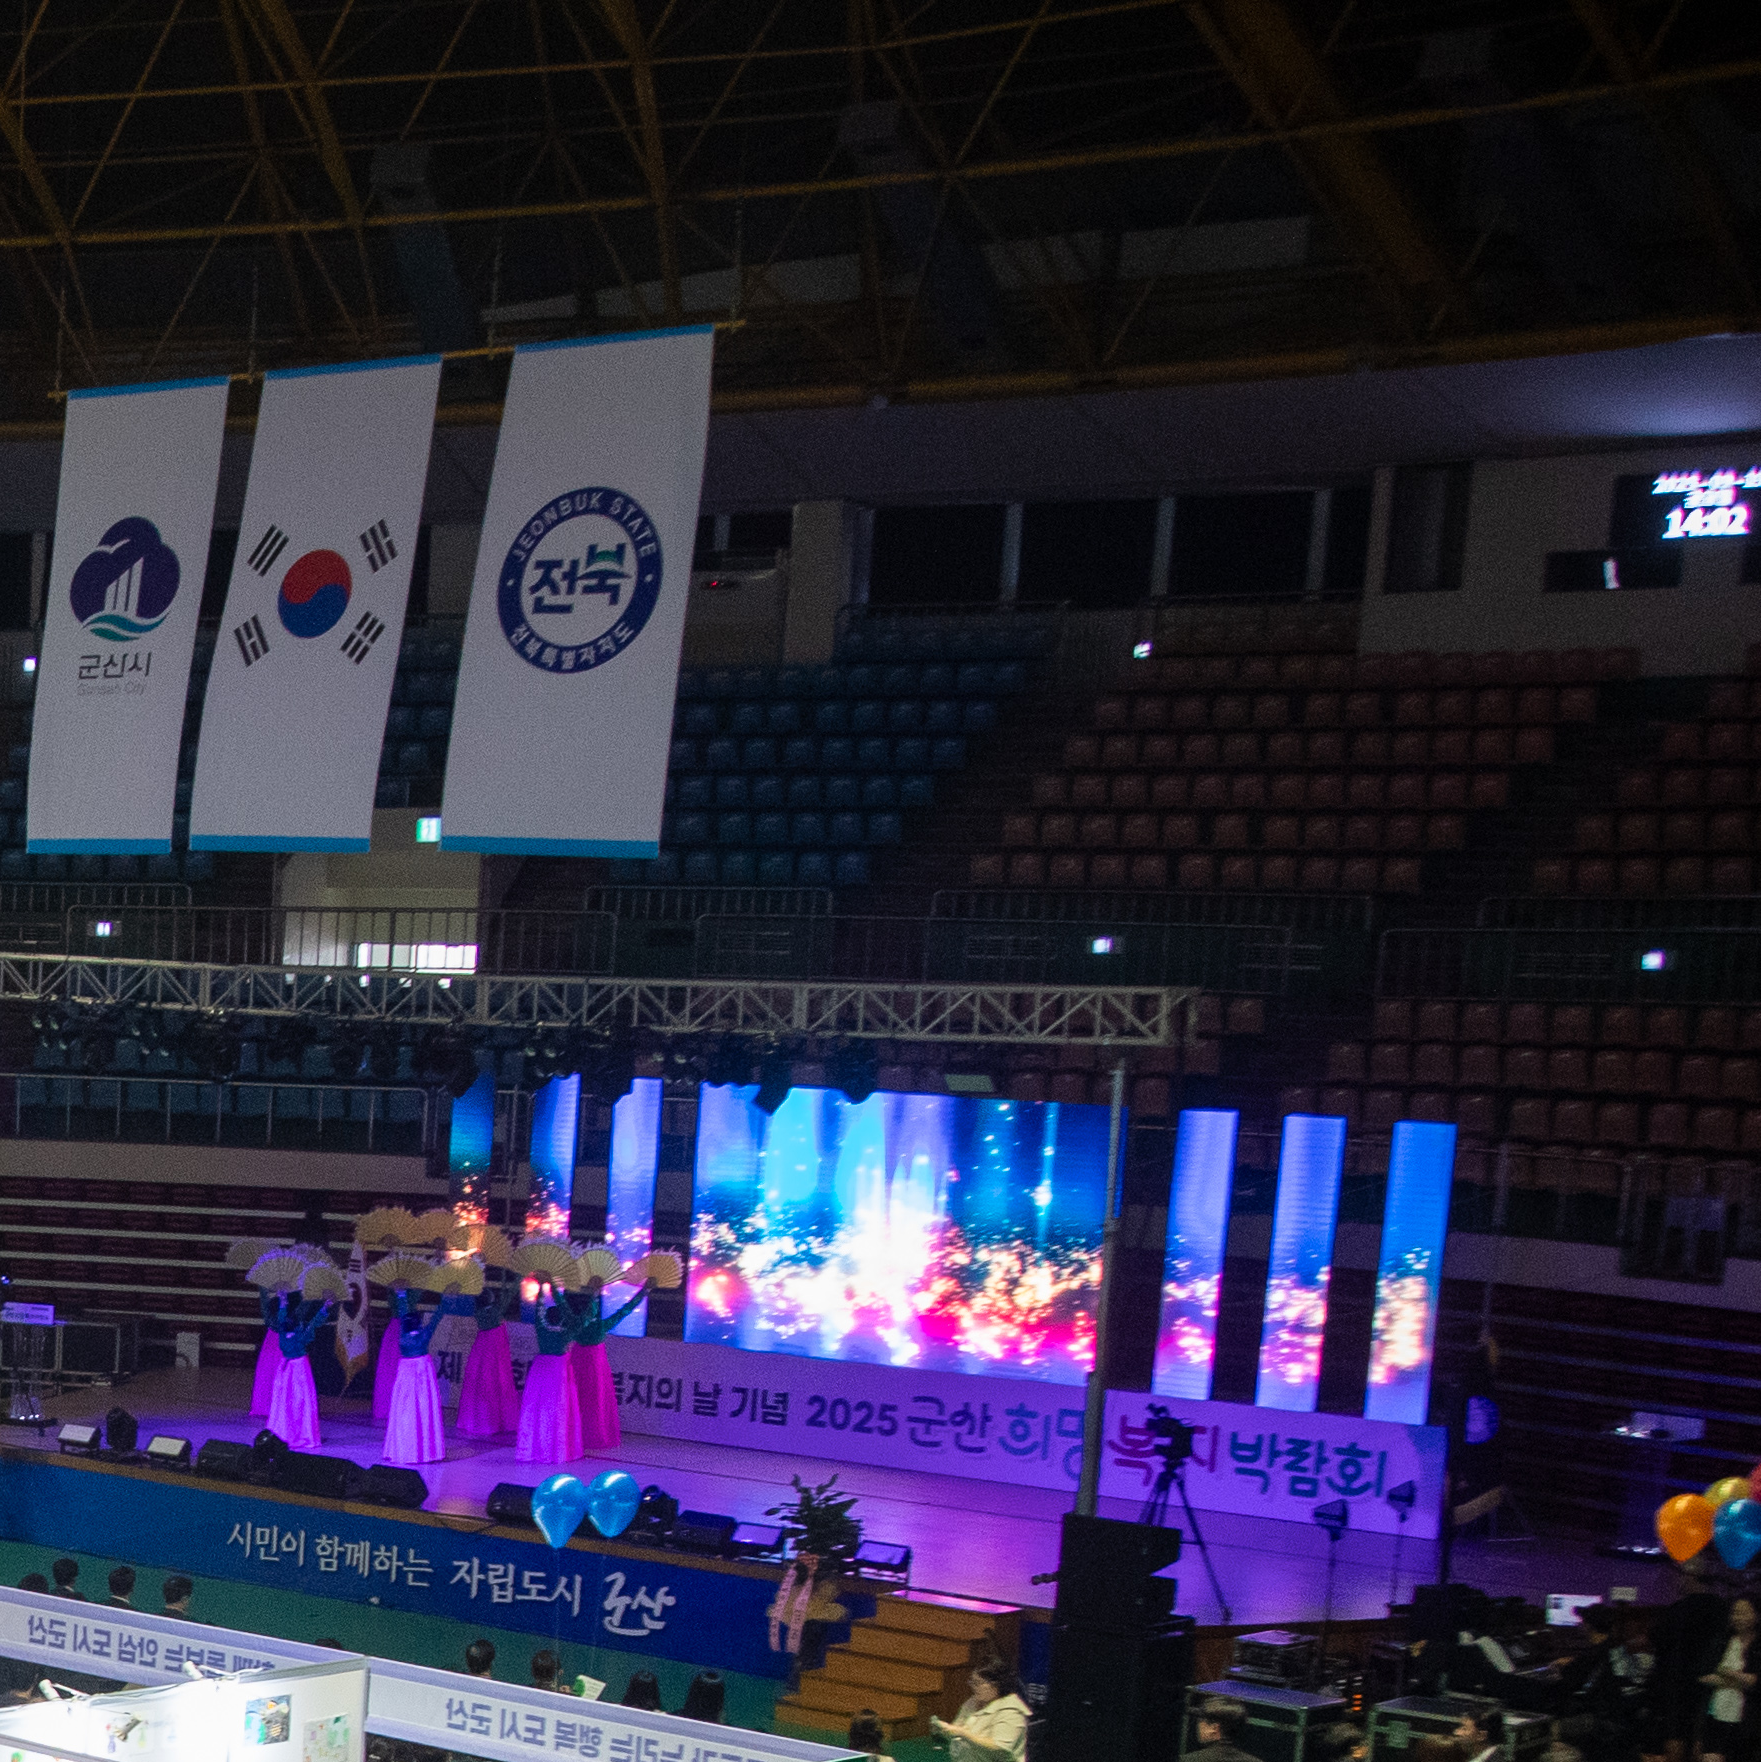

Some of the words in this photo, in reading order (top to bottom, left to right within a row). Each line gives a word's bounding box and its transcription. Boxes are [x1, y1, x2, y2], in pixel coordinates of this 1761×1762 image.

[528, 543, 633, 614] 전북
[77, 651, 153, 680] 군산시
[805, 1394, 899, 1439] 2025
[906, 1397, 993, 1455] 군산
[1229, 1431, 1389, 1501] 박람회
[228, 1520, 306, 1570] 시민이
[314, 1532, 435, 1590] 함께하는
[448, 1556, 582, 1618] 자립도시
[601, 1568, 677, 1639] 군산
